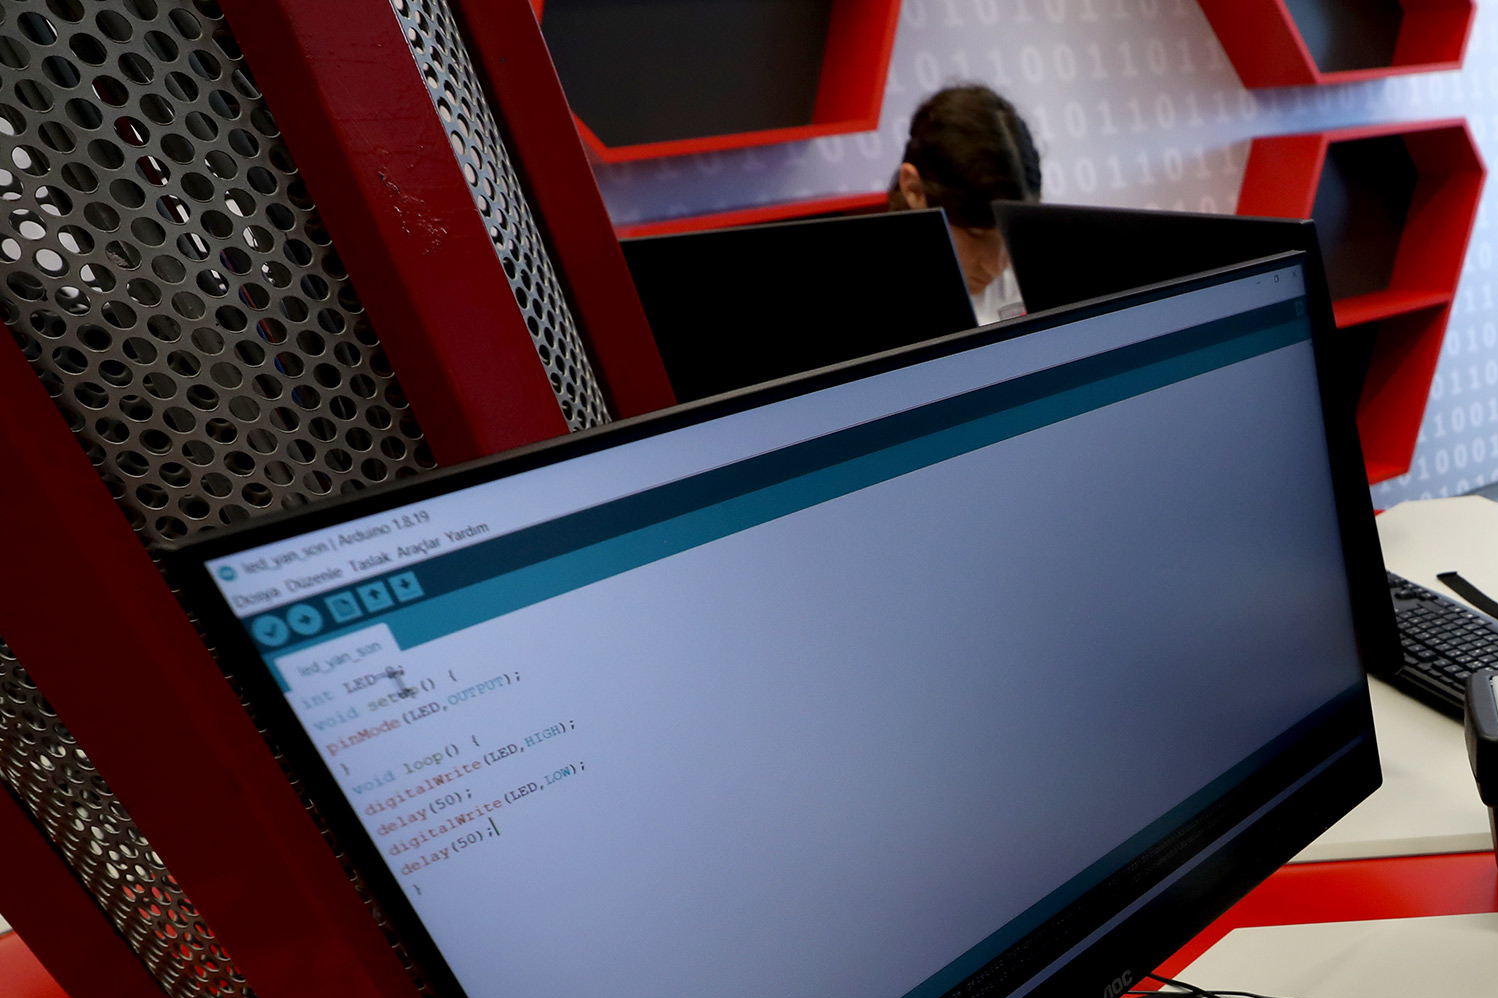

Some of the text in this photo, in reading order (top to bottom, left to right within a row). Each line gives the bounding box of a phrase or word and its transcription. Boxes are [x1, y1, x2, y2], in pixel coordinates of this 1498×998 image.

[339, 523, 391, 547] Arduino
[349, 552, 392, 572] Taslak
[396, 537, 441, 559] Araçlar
